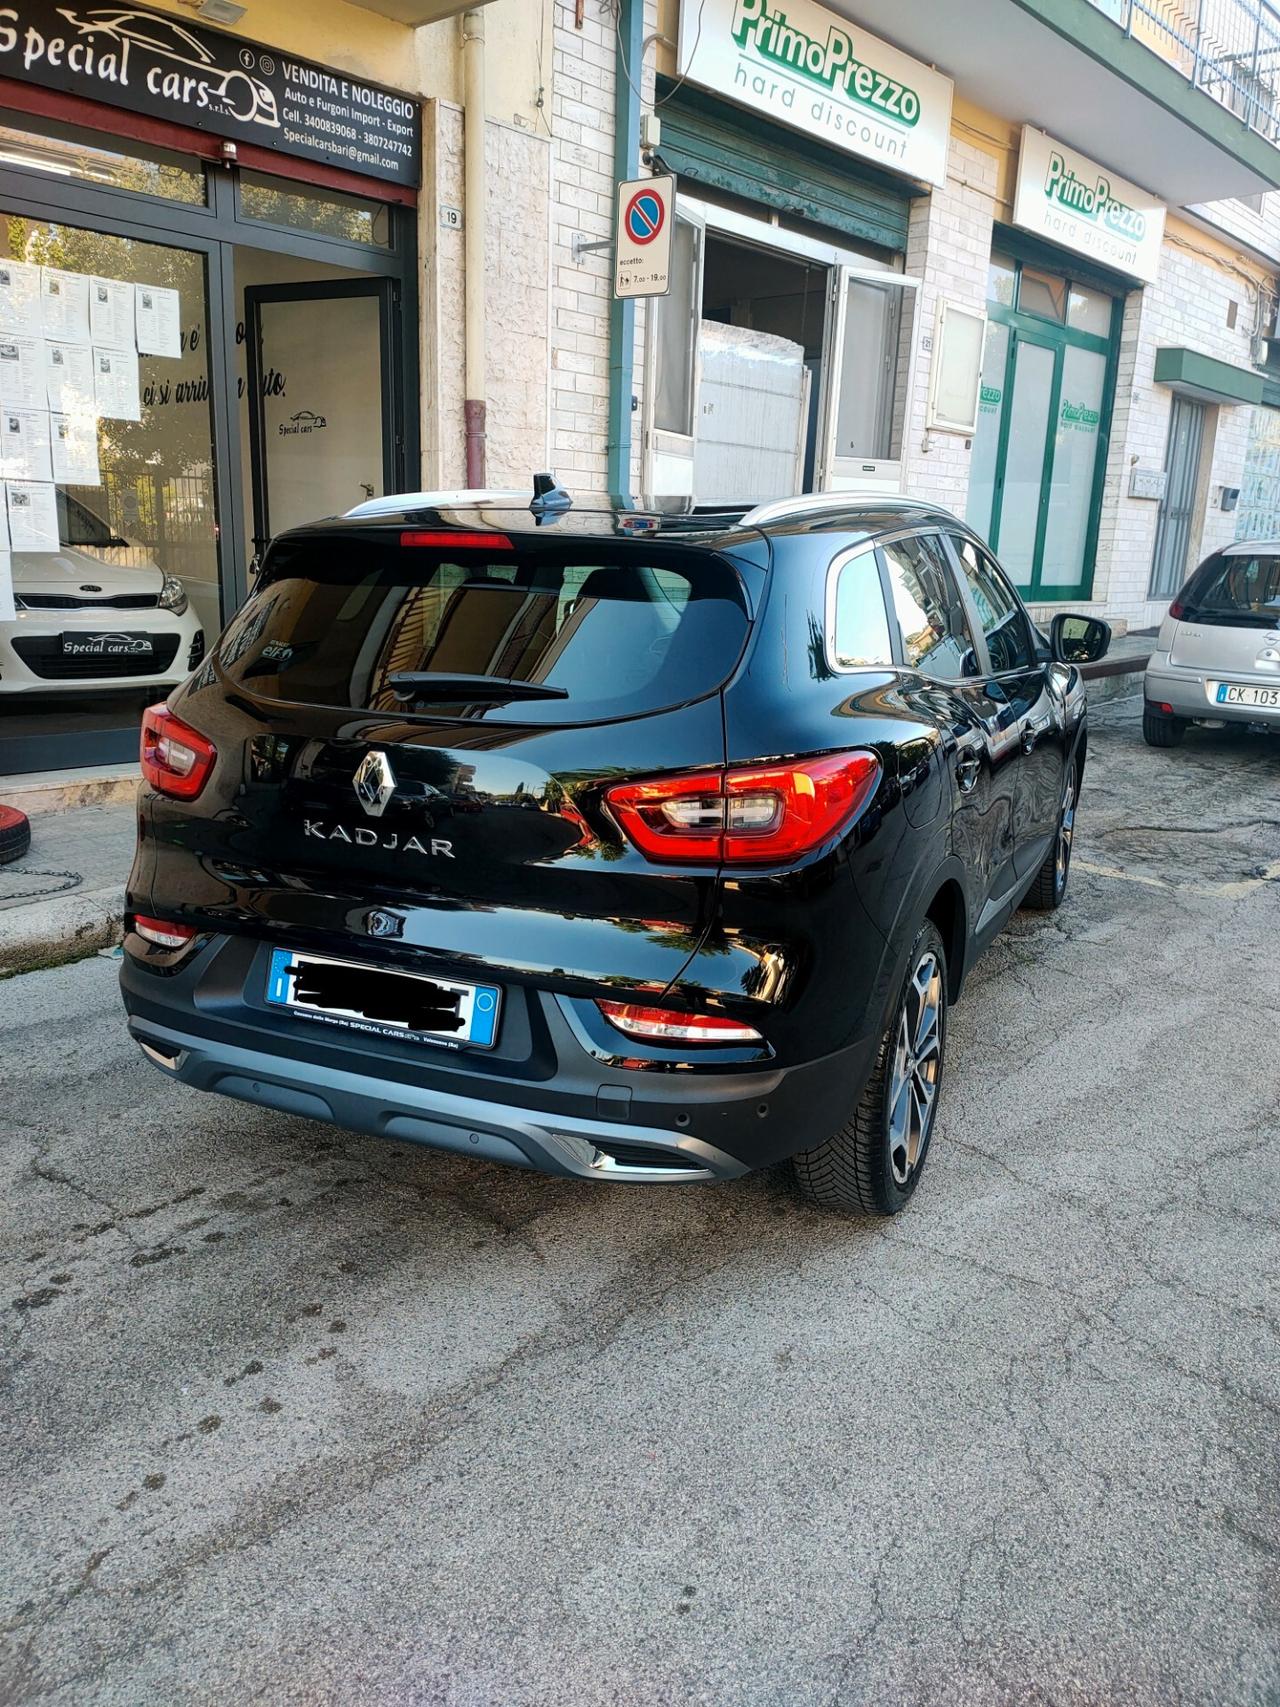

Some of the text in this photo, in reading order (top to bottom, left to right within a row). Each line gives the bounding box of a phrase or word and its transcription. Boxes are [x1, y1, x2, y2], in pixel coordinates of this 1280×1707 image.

[0, 8, 130, 86] Special
[147, 67, 209, 107] cars
[731, 0, 920, 128] PrimoPrezzo
[282, 61, 414, 120] VENDITA E NOLEGGIO
[284, 87, 307, 106] Auto
[309, 97, 315, 107] e
[316, 97, 350, 118] Furgoni
[351, 108, 381, 127] Import
[387, 120, 414, 137] Export
[734, 63, 912, 159] hard discount
[282, 107, 303, 124] Cell.
[304, 114, 357, 140] 3400839068
[363, 132, 413, 157] 3807247742
[284, 128, 399, 171] Specialcarsbari@gmail.com
[447, 211, 457, 224] 19
[1044, 151, 1146, 241] PrimoPrezzo
[1044, 210, 1138, 265] hard discount
[619, 257, 644, 266] eccetto:
[143, 381, 155, 406] ci
[159, 379, 170, 405] si
[279, 423, 313, 436] Special cars
[64, 641, 104, 655] Special
[108, 644, 128, 653] cars
[1228, 687, 1279, 705] CK 103
[304, 819, 456, 859] KADJAR
[350, 1022, 381, 1034] SPECIAL
[382, 1028, 404, 1039] CARS
